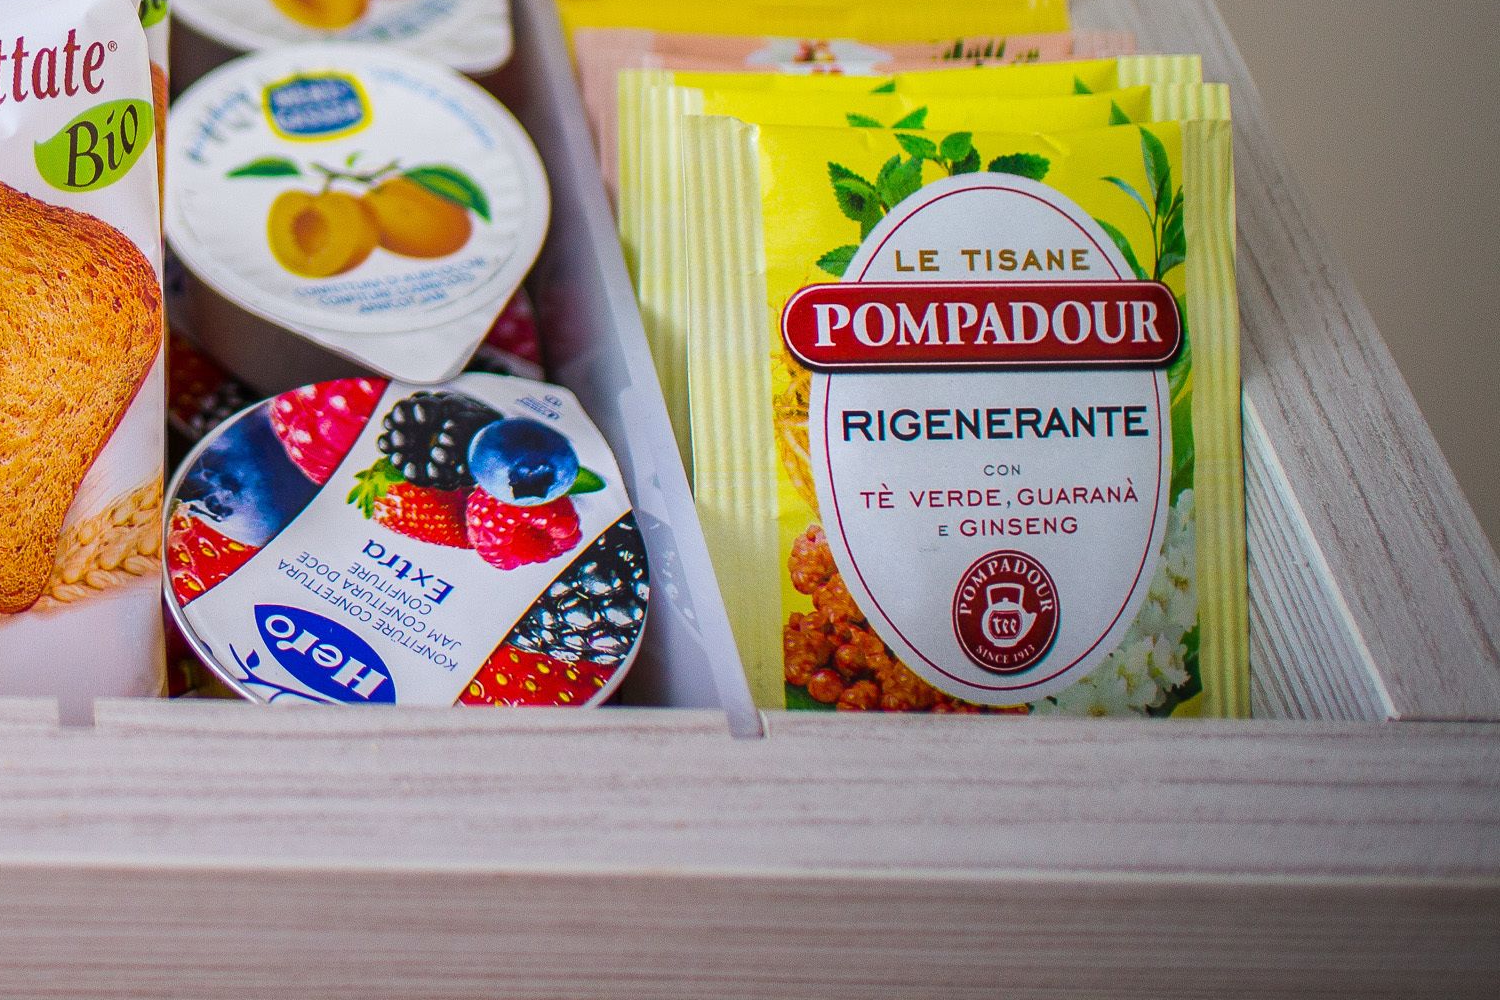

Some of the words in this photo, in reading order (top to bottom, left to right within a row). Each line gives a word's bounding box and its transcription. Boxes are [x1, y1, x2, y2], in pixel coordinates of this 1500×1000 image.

[63, 103, 139, 188] Bio
[895, 249, 939, 273] LE
[961, 248, 1090, 273] TISANE
[812, 299, 1164, 348] POMPADOUR
[842, 406, 1150, 442] RIGENERANTE
[983, 464, 1021, 476] CON
[860, 483, 895, 509] TÈ
[938, 525, 949, 537] E
[959, 516, 1079, 537] GINSENG
[278, 559, 373, 623] CONFETTURA
[296, 551, 341, 583] DOCE
[347, 561, 433, 616] CONFITURE
[362, 539, 456, 606] Extra
[959, 558, 1053, 615] POMPADOUR
[342, 577, 427, 632] CONFITURA
[265, 613, 389, 700] Hero
[372, 618, 459, 672] KONFITÜRE
[426, 628, 462, 651] JAM
[975, 644, 1009, 664] SINCE
[1013, 643, 1036, 662] 1913
